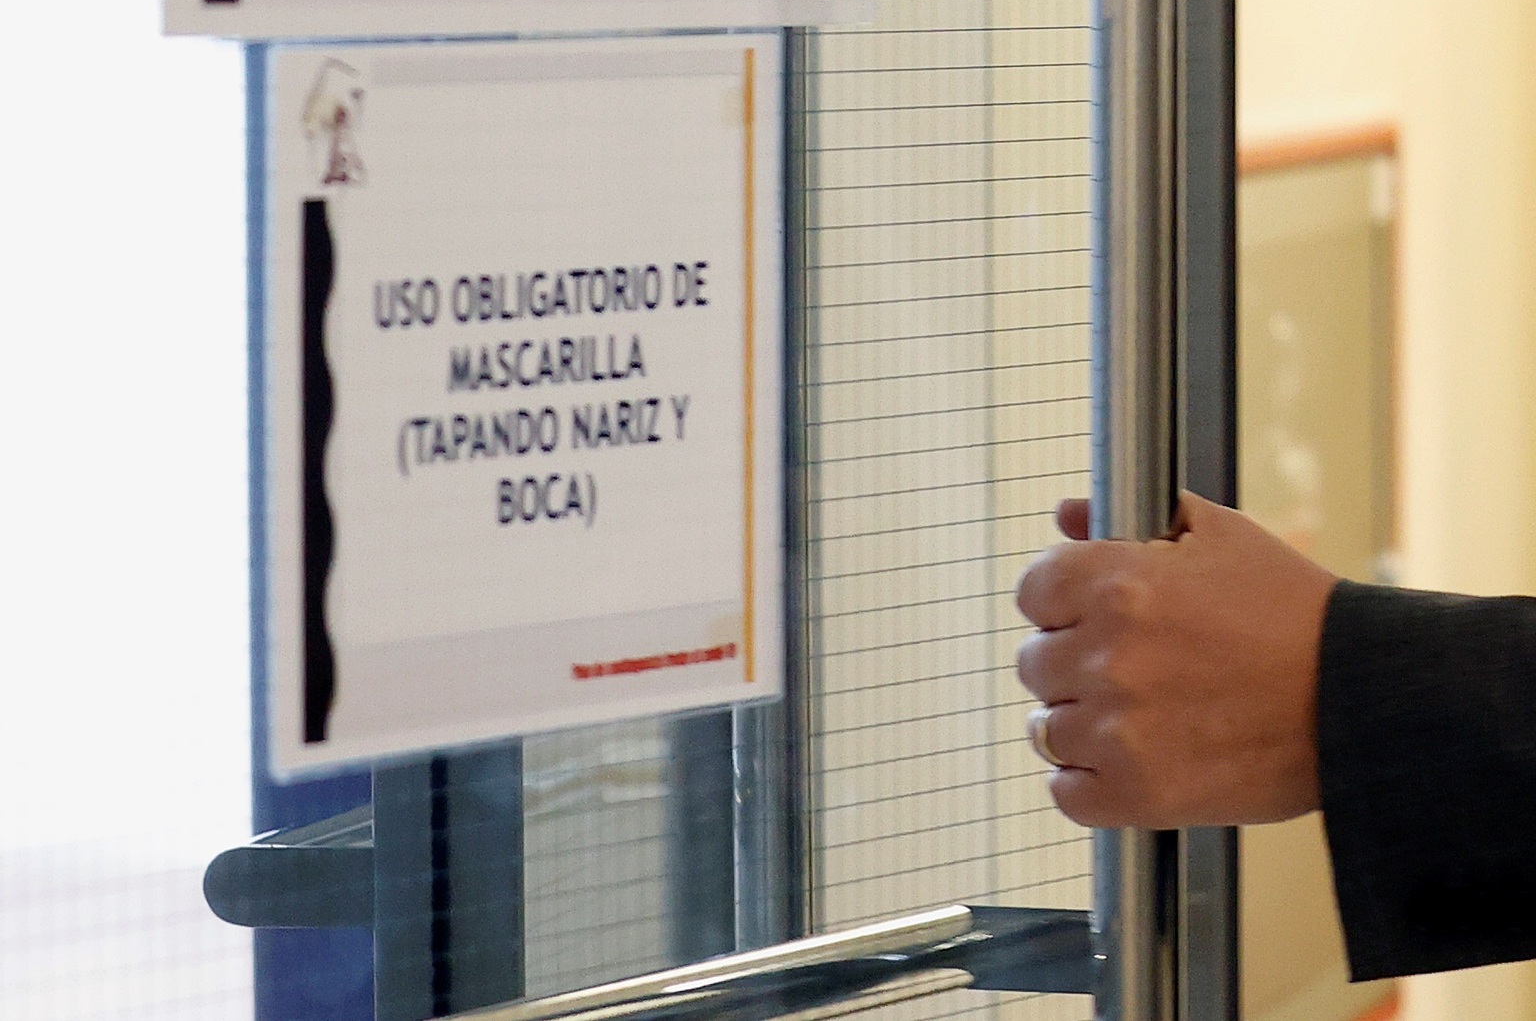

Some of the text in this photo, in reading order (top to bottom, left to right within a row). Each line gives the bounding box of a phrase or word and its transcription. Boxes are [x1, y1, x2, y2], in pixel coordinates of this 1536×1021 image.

[374, 261, 709, 330] USO OBLIGATORIO DE
[448, 333, 647, 396] MASCARILLA
[397, 394, 691, 477] (TAPANDO NARIZ Y
[497, 474, 598, 529] BOCA)
